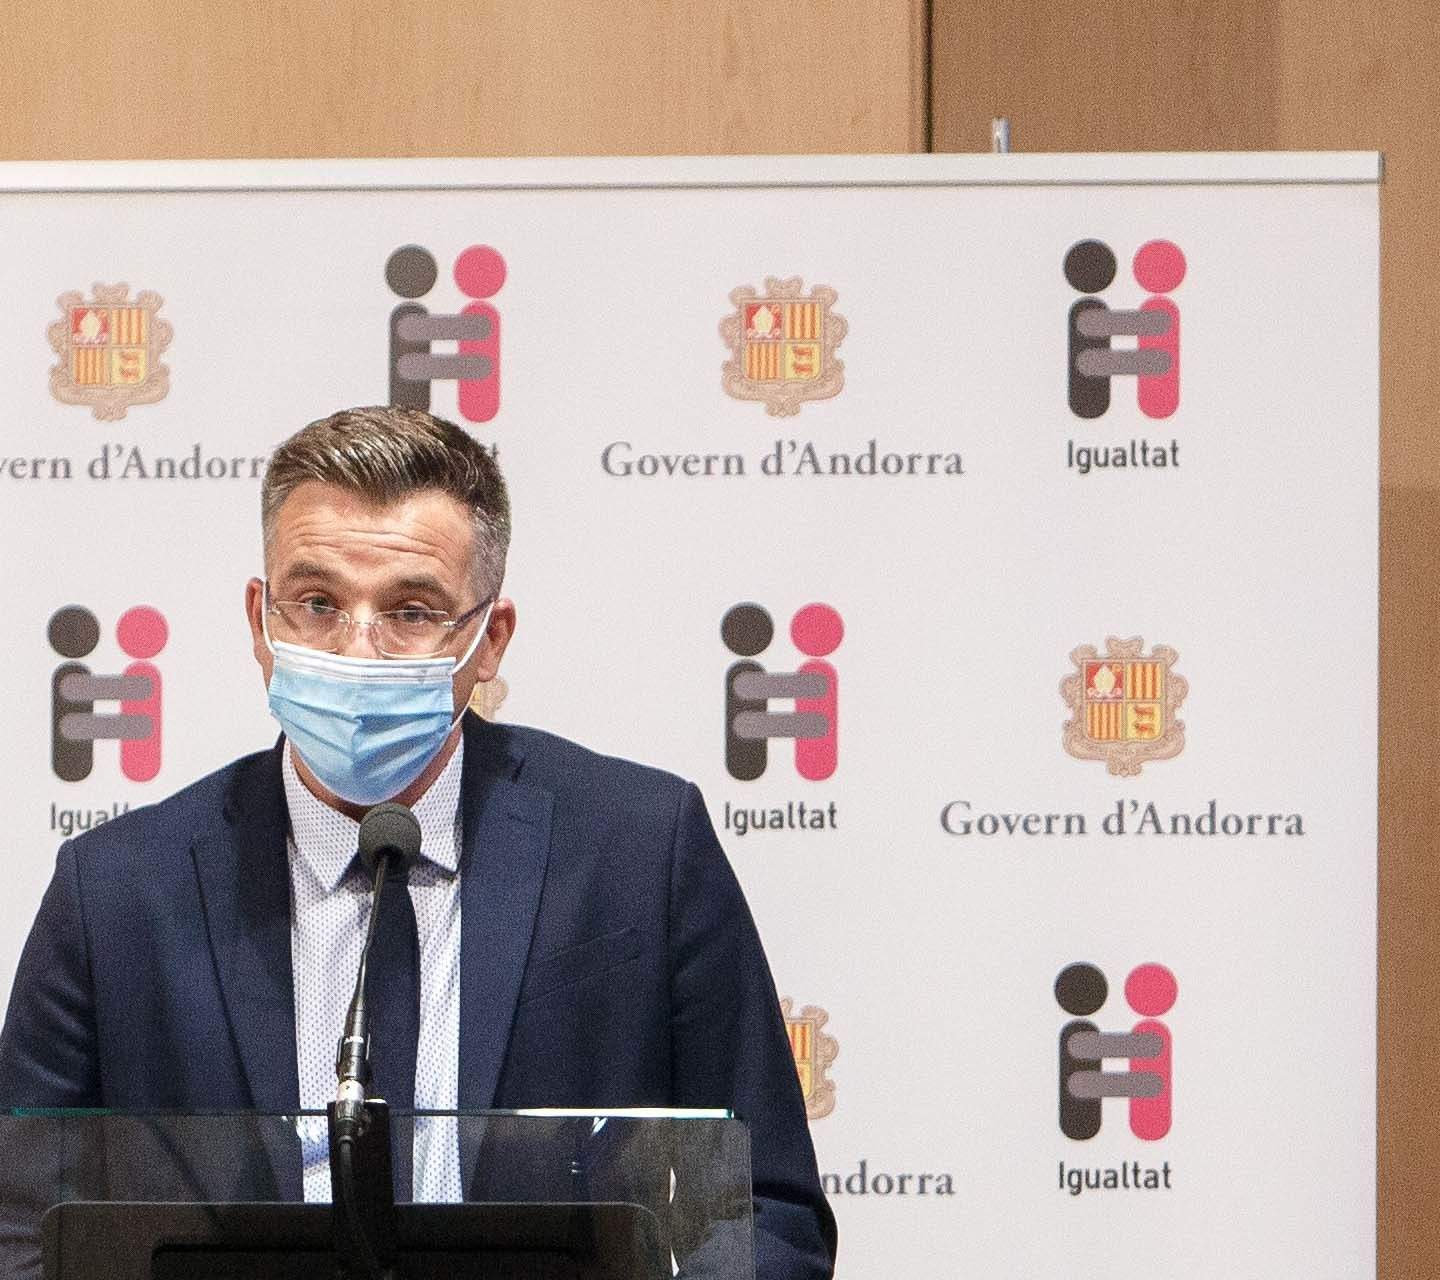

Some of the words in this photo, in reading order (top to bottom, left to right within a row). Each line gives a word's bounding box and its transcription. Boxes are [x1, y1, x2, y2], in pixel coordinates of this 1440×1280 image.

[87, 443, 266, 480] d'Andorr
[600, 441, 746, 477] Govern
[760, 439, 964, 477] d'Andorra
[1066, 440, 1180, 476] Igualtat
[724, 801, 838, 837] Igualtat
[939, 801, 1087, 837] Govern
[1101, 799, 1305, 837] d'Andorra
[820, 1159, 956, 1196] ndorra
[1057, 1160, 1172, 1197] Igualtat
